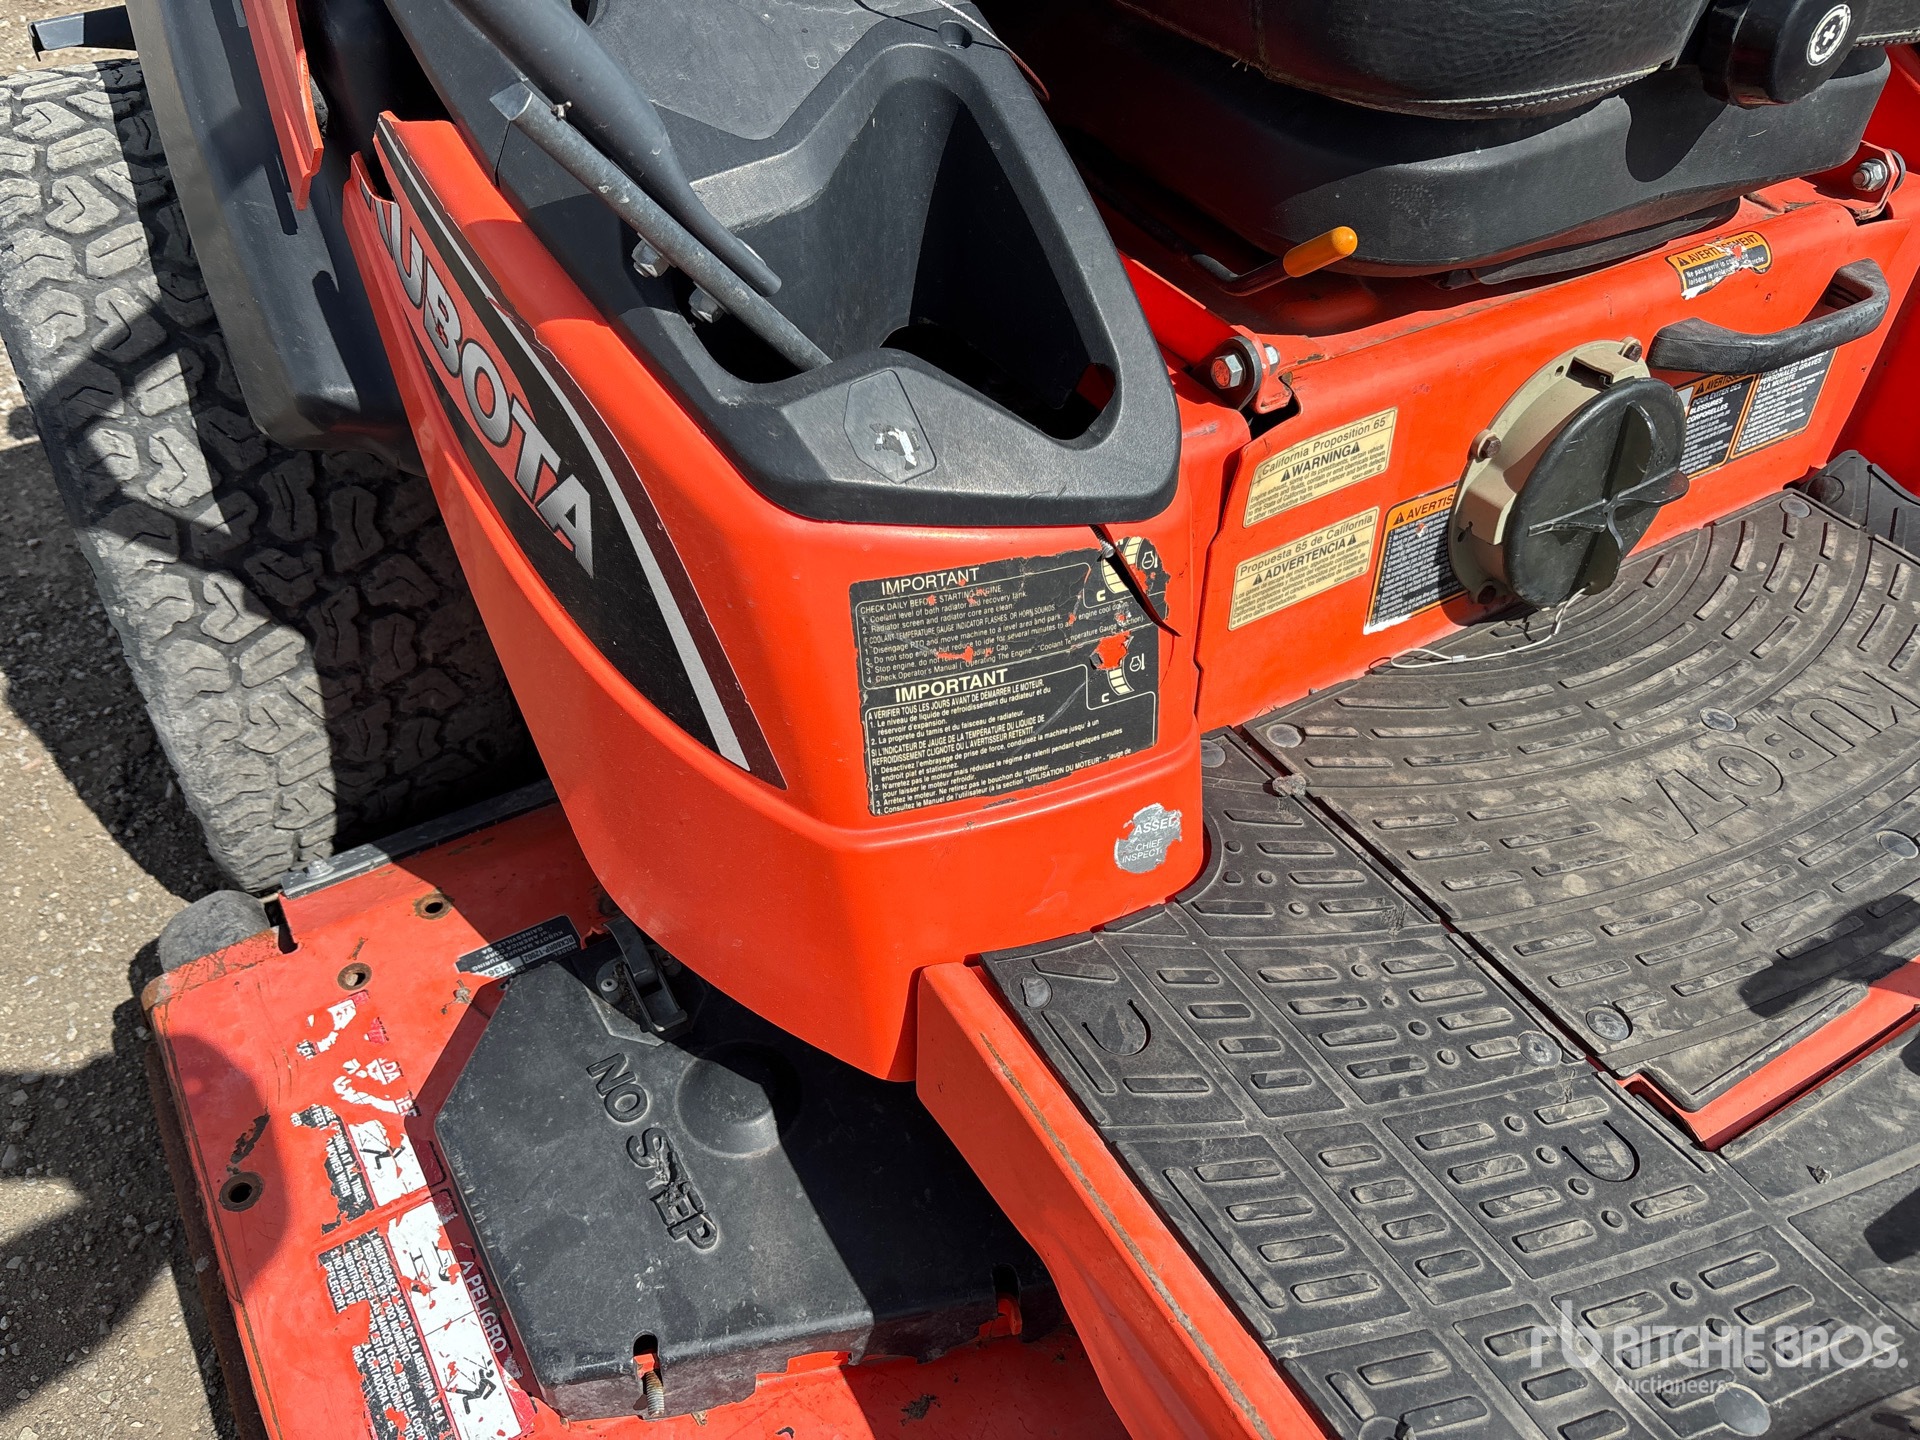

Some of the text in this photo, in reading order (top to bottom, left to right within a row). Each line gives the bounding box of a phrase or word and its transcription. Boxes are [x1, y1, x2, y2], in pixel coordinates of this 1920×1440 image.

[1262, 417, 1386, 476] California Proposition 65
[1291, 445, 1351, 478] WARNING
[1240, 515, 1373, 577] Propuesta 65 de California
[1264, 540, 1346, 581] ADVERTENCIA
[880, 567, 980, 595] IMPORTANT
[860, 604, 885, 614] CHECK
[886, 600, 907, 610] DAILY
[909, 595, 937, 606] BEFOE
[870, 612, 896, 622] Coolant
[898, 609, 913, 617] level
[924, 605, 939, 613] both
[940, 600, 966, 610] radiator
[982, 594, 1011, 604] recovery
[871, 621, 899, 632] Radiator
[940, 610, 965, 620] radiator
[868, 632, 895, 643] COOLANT
[896, 626, 934, 638] TEMPERATURE
[935, 622, 955, 632] GAUGE
[956, 617, 983, 628] INDICATOR
[1018, 609, 1033, 617] HORN
[872, 641, 908, 655] Disengage
[910, 638, 924, 647] PTO
[926, 636, 938, 644] and
[960, 627, 986, 637] machine
[1002, 621, 1017, 630] level
[895, 668, 1008, 702] IMPORTANT
[901, 705, 917, 714] TOUS
[918, 703, 929, 711] LES
[930, 699, 950, 709] JOURS
[951, 695, 969, 705] AVANT
[926, 726, 942, 734] tamis
[961, 718, 986, 727] faisceau
[996, 710, 1024, 720] radiateur.
[927, 736, 946, 746] JAUGE
[1015, 717, 1036, 727] LIQUIDE
[872, 750, 925, 767] REFROIDISSEMENT
[926, 744, 954, 755] CLIGNOTE
[1612, 670, 1920, 842] KUBOTA
[1135, 838, 1163, 851] CHIEF
[586, 1052, 649, 1124] NO
[332, 1255, 344, 1271] NO
[342, 1251, 363, 1292] MIENTRAS
[361, 1241, 383, 1286] DESCARGA
[376, 1283, 388, 1297] EN
[371, 1237, 397, 1290] MANTENGASE
[337, 1268, 351, 1294] HAGA
[466, 1273, 508, 1353] PELIGRO
[352, 1246, 418, 1419] NO COLOQUE LAS MANOS PIES EN LA
[403, 1325, 416, 1341] DE
[408, 1337, 420, 1352] LA
[412, 1349, 437, 1397] ABERTURA
[433, 1409, 448, 1425] LA
